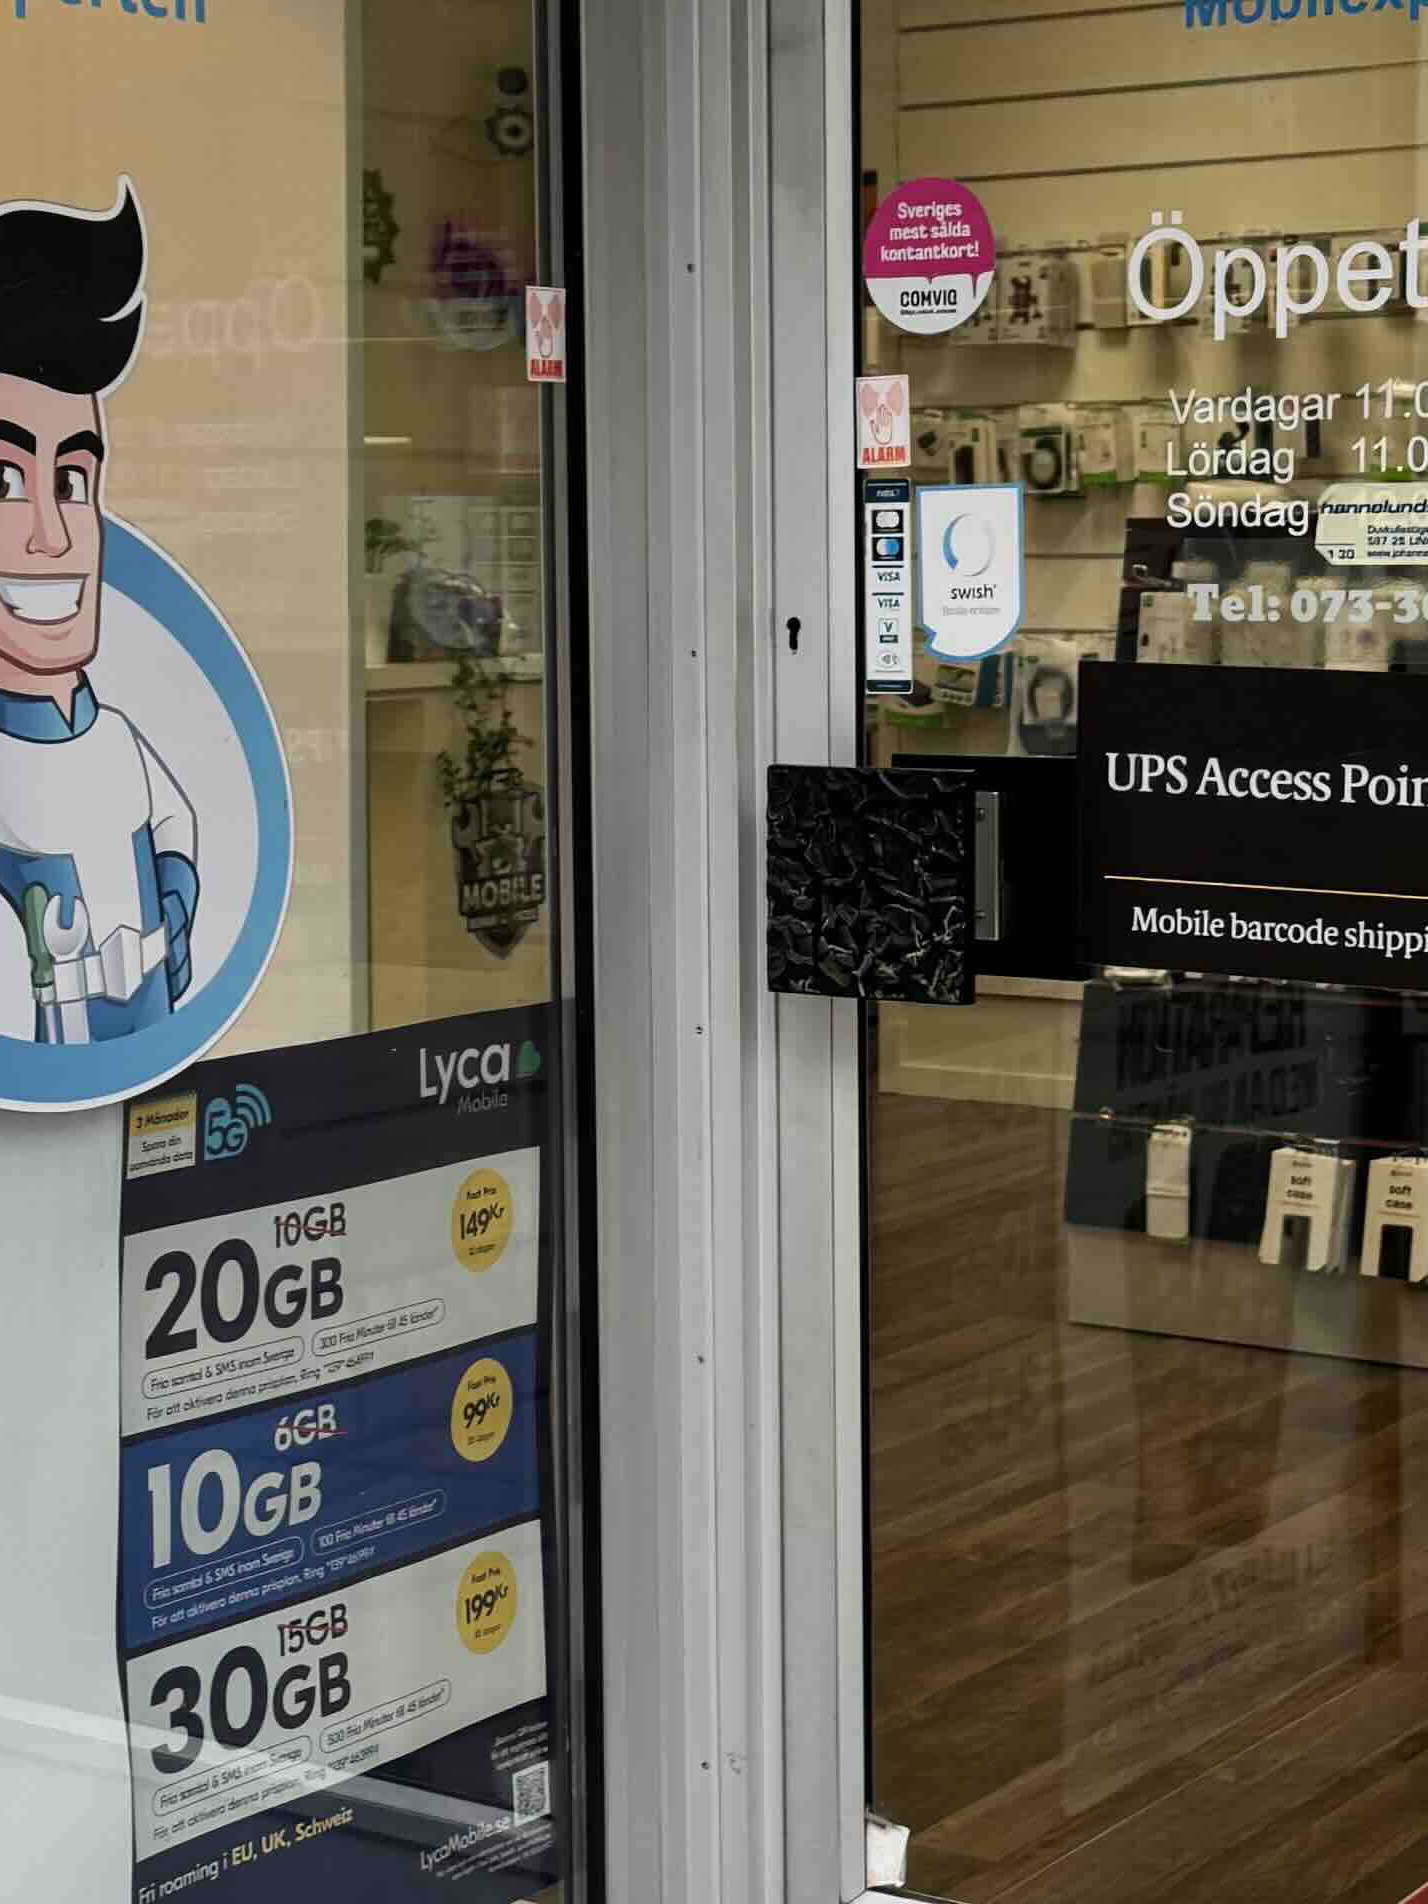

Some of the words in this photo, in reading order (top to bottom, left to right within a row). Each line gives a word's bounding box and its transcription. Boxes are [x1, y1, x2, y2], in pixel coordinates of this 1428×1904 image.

[889, 223, 926, 242] mest
[929, 219, 972, 240] sålda
[897, 201, 963, 226] Sveriges
[879, 241, 980, 262] kontantkort!
[899, 289, 957, 309] COMVIQ
[530, 359, 564, 379] ALARM
[1169, 387, 1340, 432] Vardagar
[861, 446, 907, 465] ALARM
[1166, 440, 1295, 484] Lördag
[1166, 495, 1309, 537] Söndag
[877, 571, 901, 582] VISA
[951, 584, 993, 600] swish
[1187, 583, 1282, 623] Tel:
[1105, 751, 1188, 796] UPS
[1196, 756, 1331, 804] Access
[462, 874, 542, 911] MOBILE
[1131, 905, 1225, 939] Mobile
[1231, 911, 1339, 948] barcode
[419, 1041, 511, 1104] Lyca
[456, 1091, 509, 1115] Mobile
[207, 1110, 244, 1155] 5G
[1286, 1189, 1313, 1201] case
[1290, 1176, 1312, 1186] soft
[1388, 1185, 1411, 1197] soft
[1384, 1199, 1413, 1210] case
[274, 1202, 347, 1250] 10GB
[144, 1238, 344, 1361] 20GB
[273, 1403, 338, 1452] 6GB
[146, 1447, 323, 1570] 10GB
[278, 1602, 349, 1658] 15GB
[150, 1645, 353, 1776] 30GB
[158, 1858, 220, 1903] roaming
[231, 1838, 258, 1869] EU,
[261, 1825, 292, 1861] UK,
[294, 1805, 355, 1845] Schweiz
